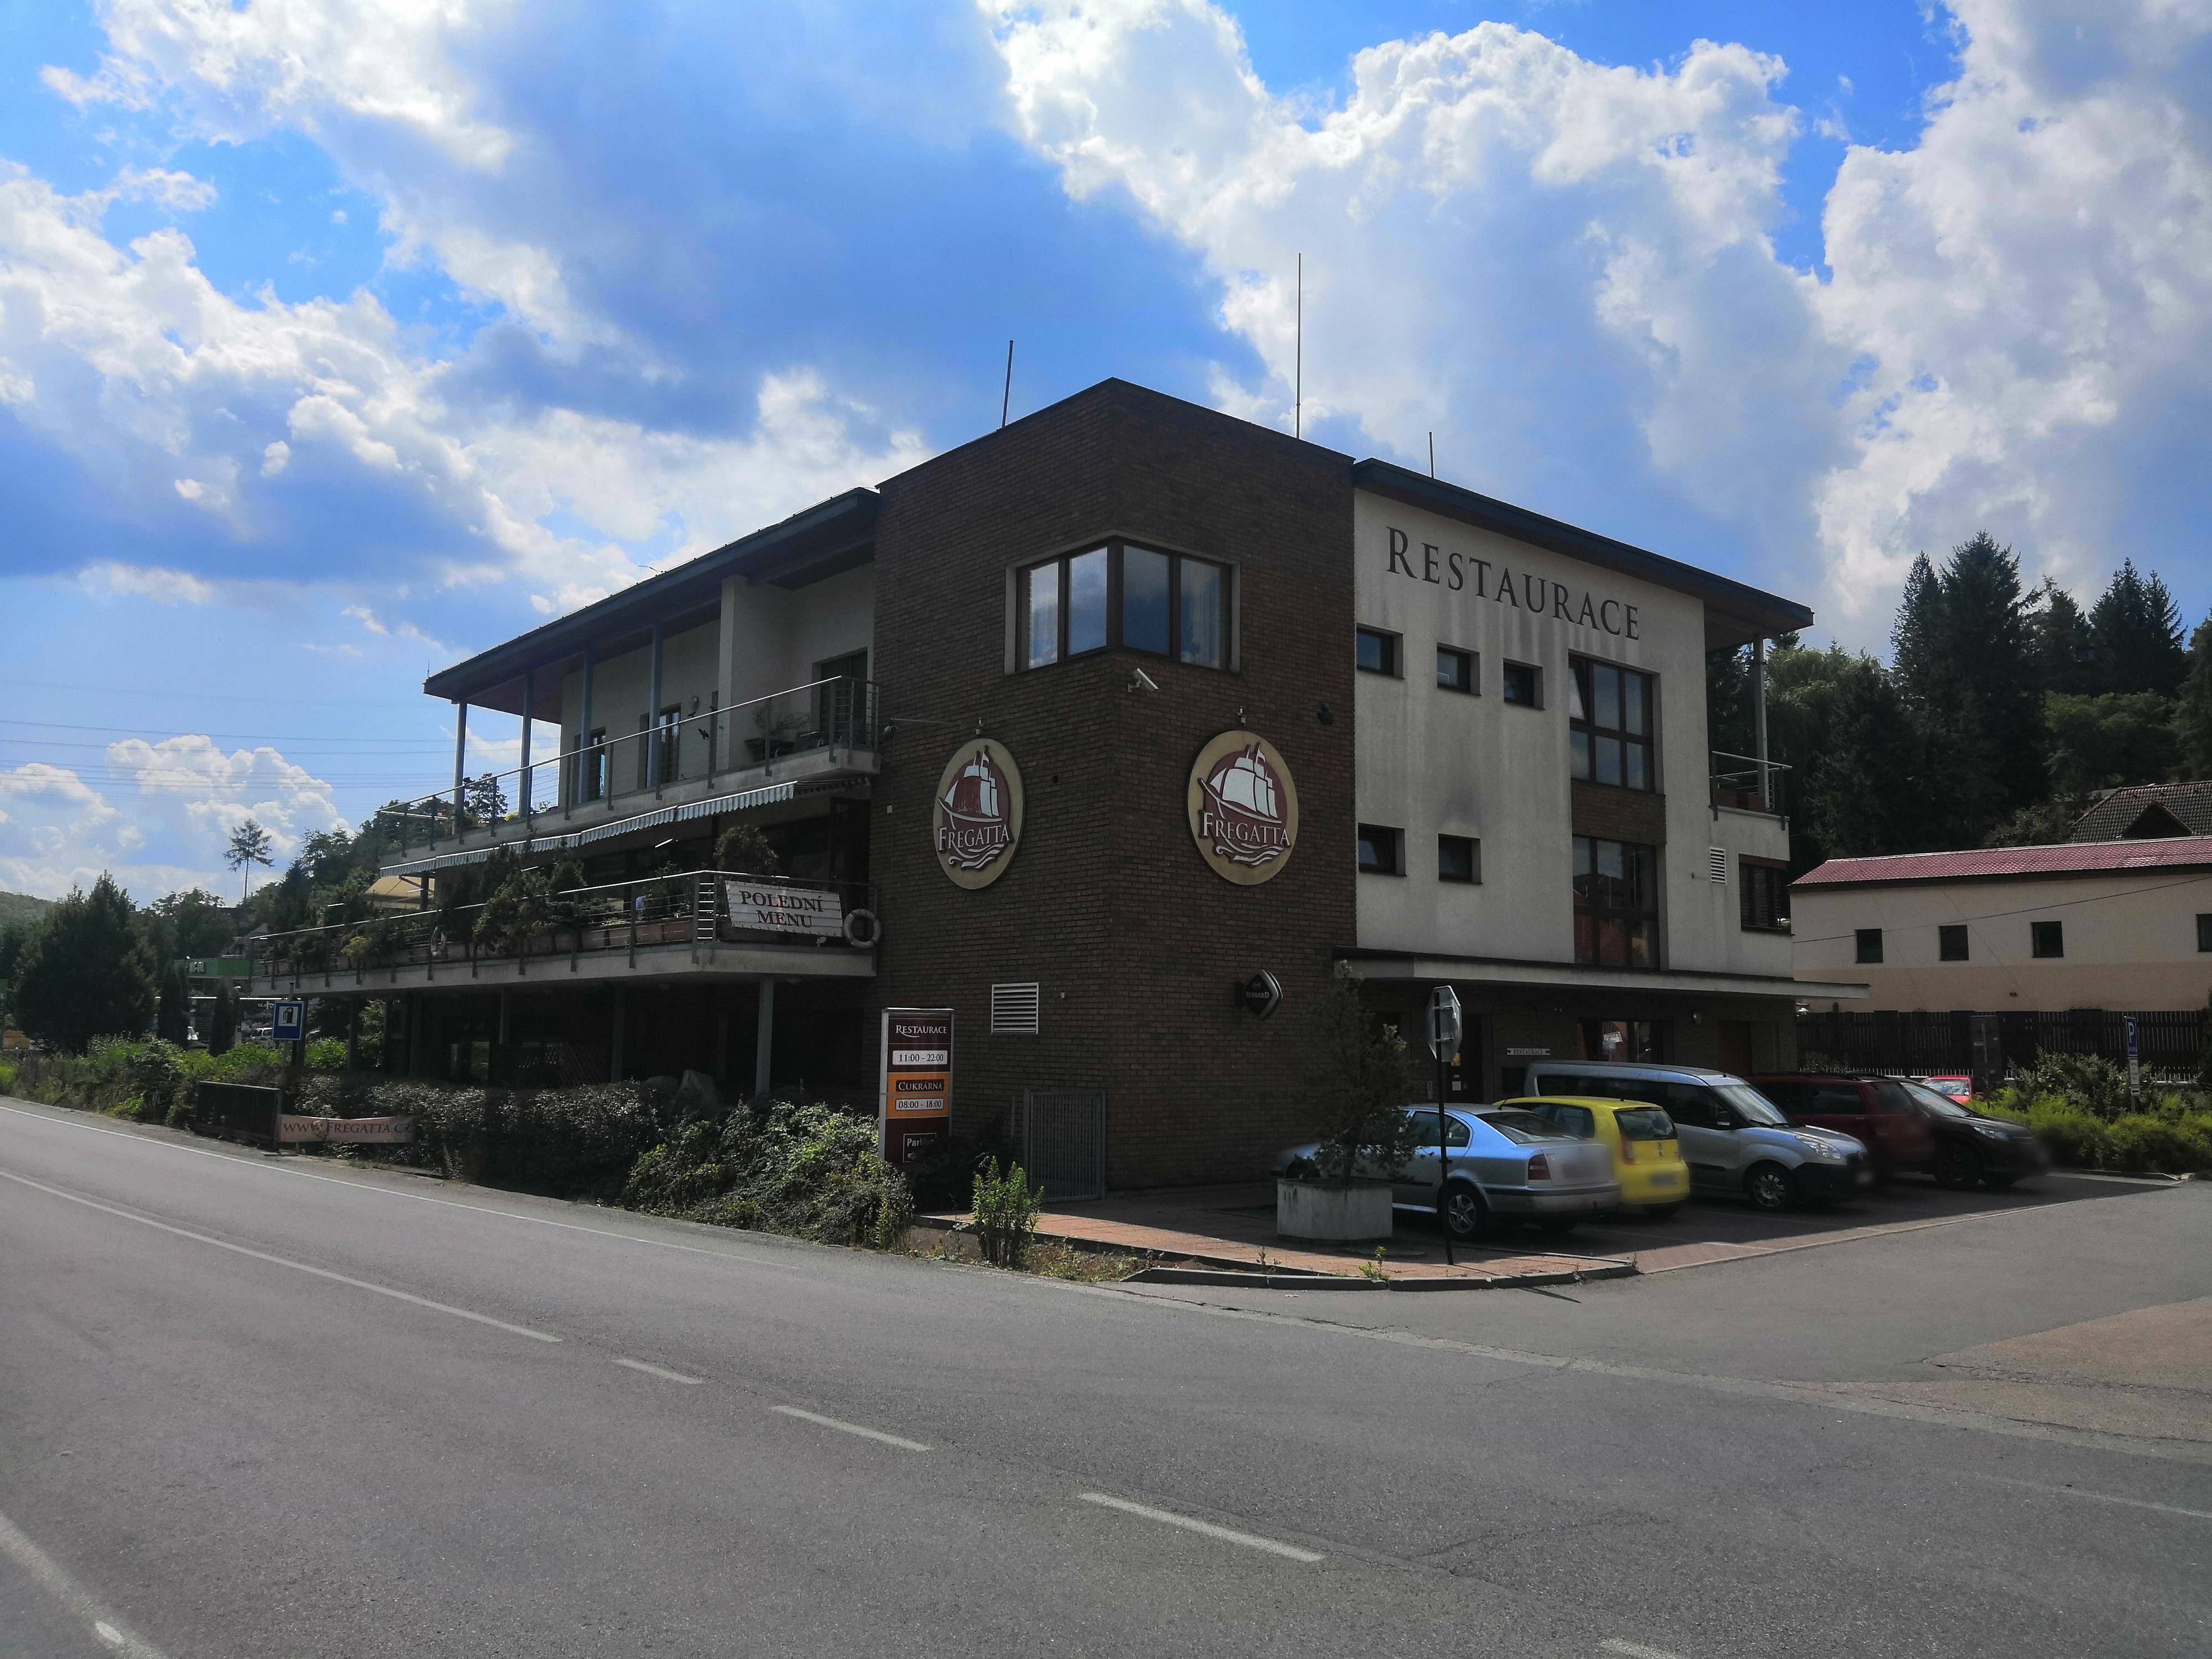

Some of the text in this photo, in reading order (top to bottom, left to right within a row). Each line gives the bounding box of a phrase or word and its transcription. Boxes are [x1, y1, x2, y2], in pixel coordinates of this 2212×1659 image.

[1385, 526, 1639, 641] RESTAURACE
[1201, 811, 1292, 847] FREGATTA
[938, 823, 1010, 854] FREGATTA
[739, 890, 824, 912] POLEDNÍ
[755, 910, 812, 928] MENU
[896, 1025, 947, 1036] RESTAURACE
[899, 1053, 920, 1062] 11:00
[927, 1053, 943, 1062] 22:00
[898, 1081, 942, 1091] CUKRÁRNA
[899, 1100, 919, 1109] 08:00
[926, 1100, 942, 1108] 18:00
[284, 1122, 412, 1133] WWFREGATTA.CZ
